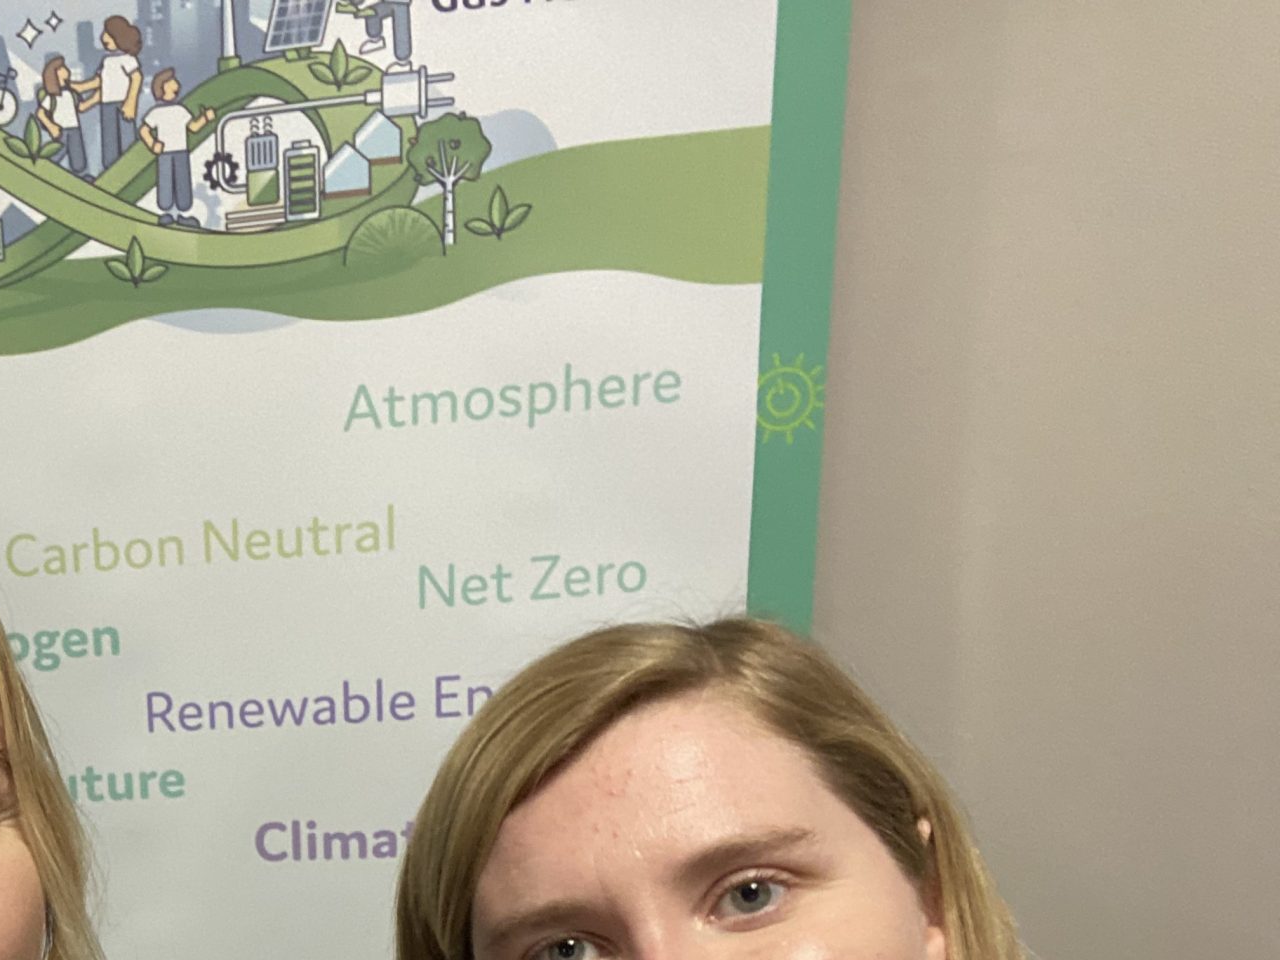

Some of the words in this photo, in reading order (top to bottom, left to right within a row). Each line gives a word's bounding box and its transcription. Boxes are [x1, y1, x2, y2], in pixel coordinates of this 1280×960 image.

[343, 362, 683, 433] Atmosphere
[5, 526, 186, 578] Carbon
[202, 504, 397, 565] Neutral
[418, 562, 514, 610] Net
[529, 553, 649, 602] Zero
[6, 625, 121, 672] ogen
[146, 677, 416, 734] Renewable
[434, 674, 494, 719] En
